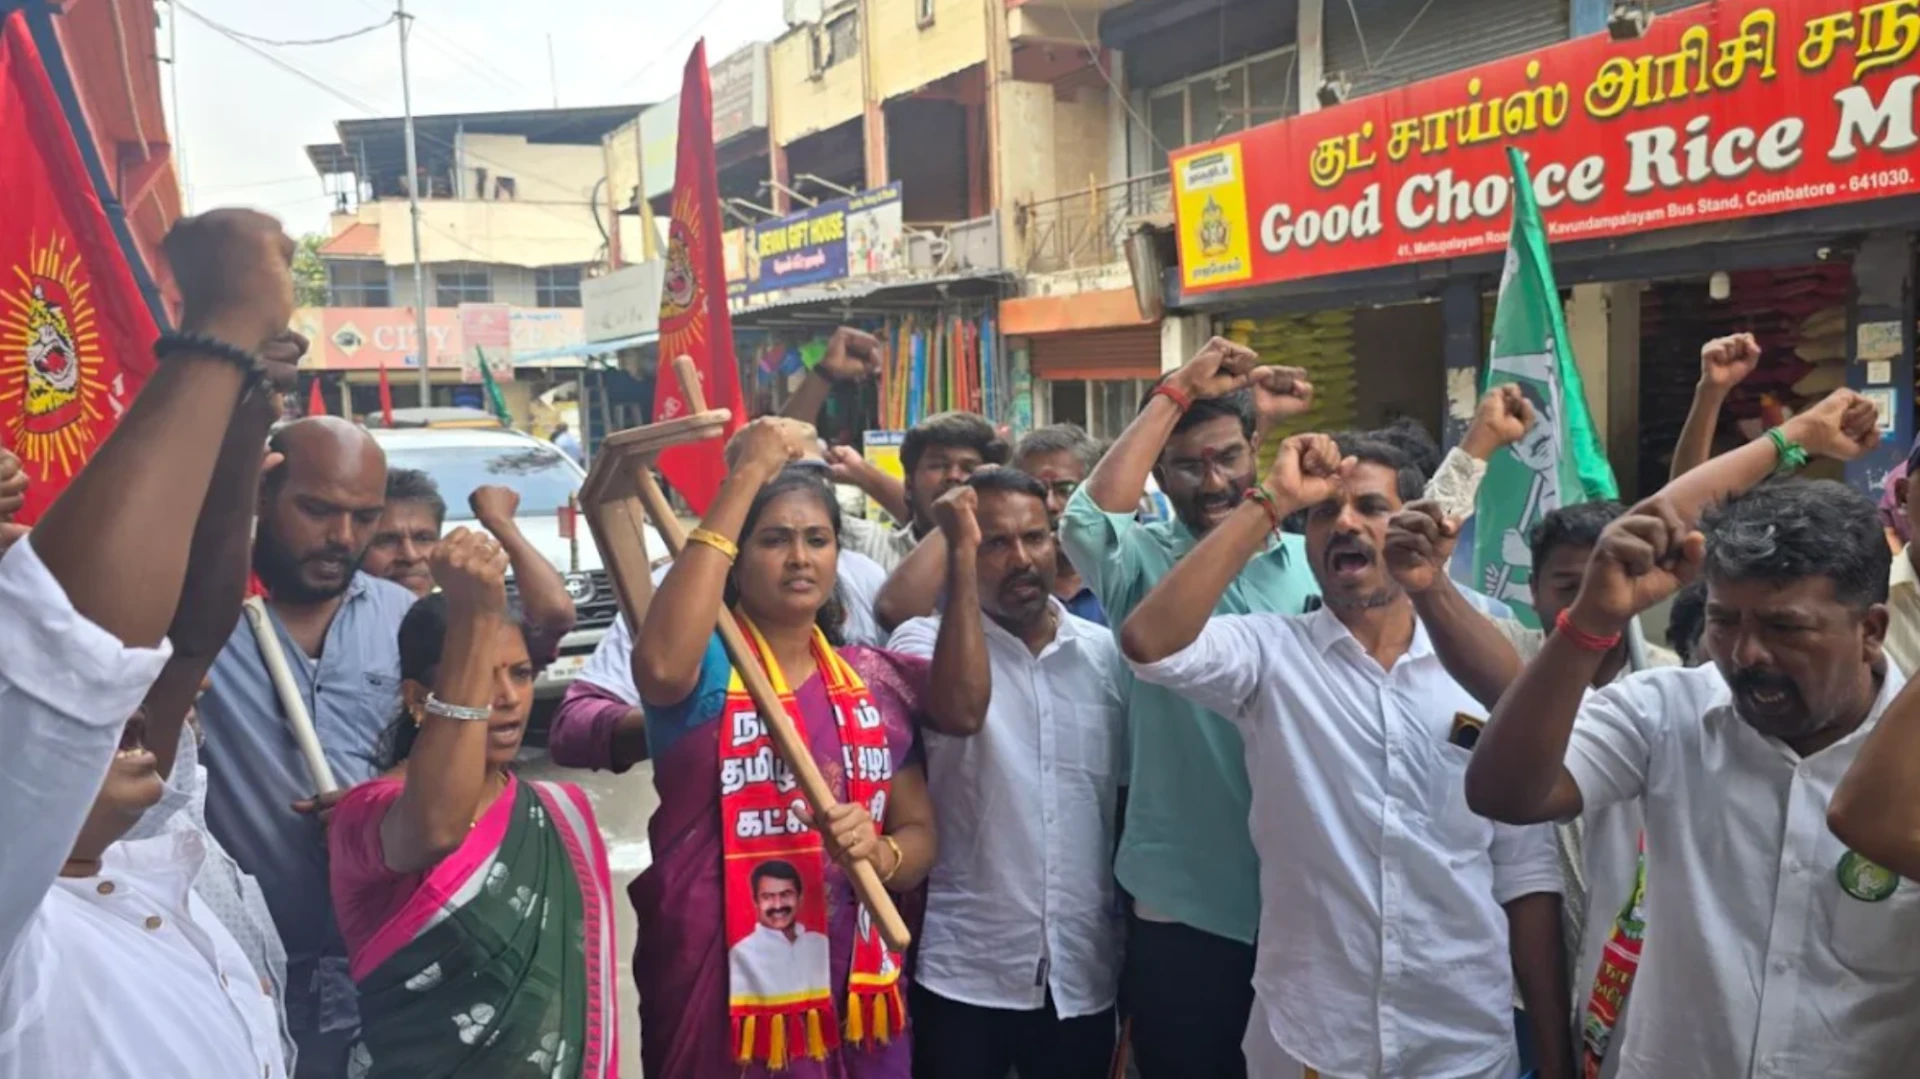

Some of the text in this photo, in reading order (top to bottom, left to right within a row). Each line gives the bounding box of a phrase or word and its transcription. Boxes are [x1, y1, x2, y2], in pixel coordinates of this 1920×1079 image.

[1584, 8, 1776, 117] அரிசி
[1261, 182, 1384, 252] Good
[1624, 115, 1804, 193] Rice
[1828, 74, 1919, 159] M
[1485, 230, 1510, 244] Roa
[1548, 208, 1664, 236] Kavundampalayam
[1667, 202, 1694, 218] Bus
[1697, 192, 1743, 214] Stand,
[1746, 181, 1836, 206] Coimbatore
[1849, 167, 1914, 192] 641030.
[810, 210, 845, 245] HOUSE
